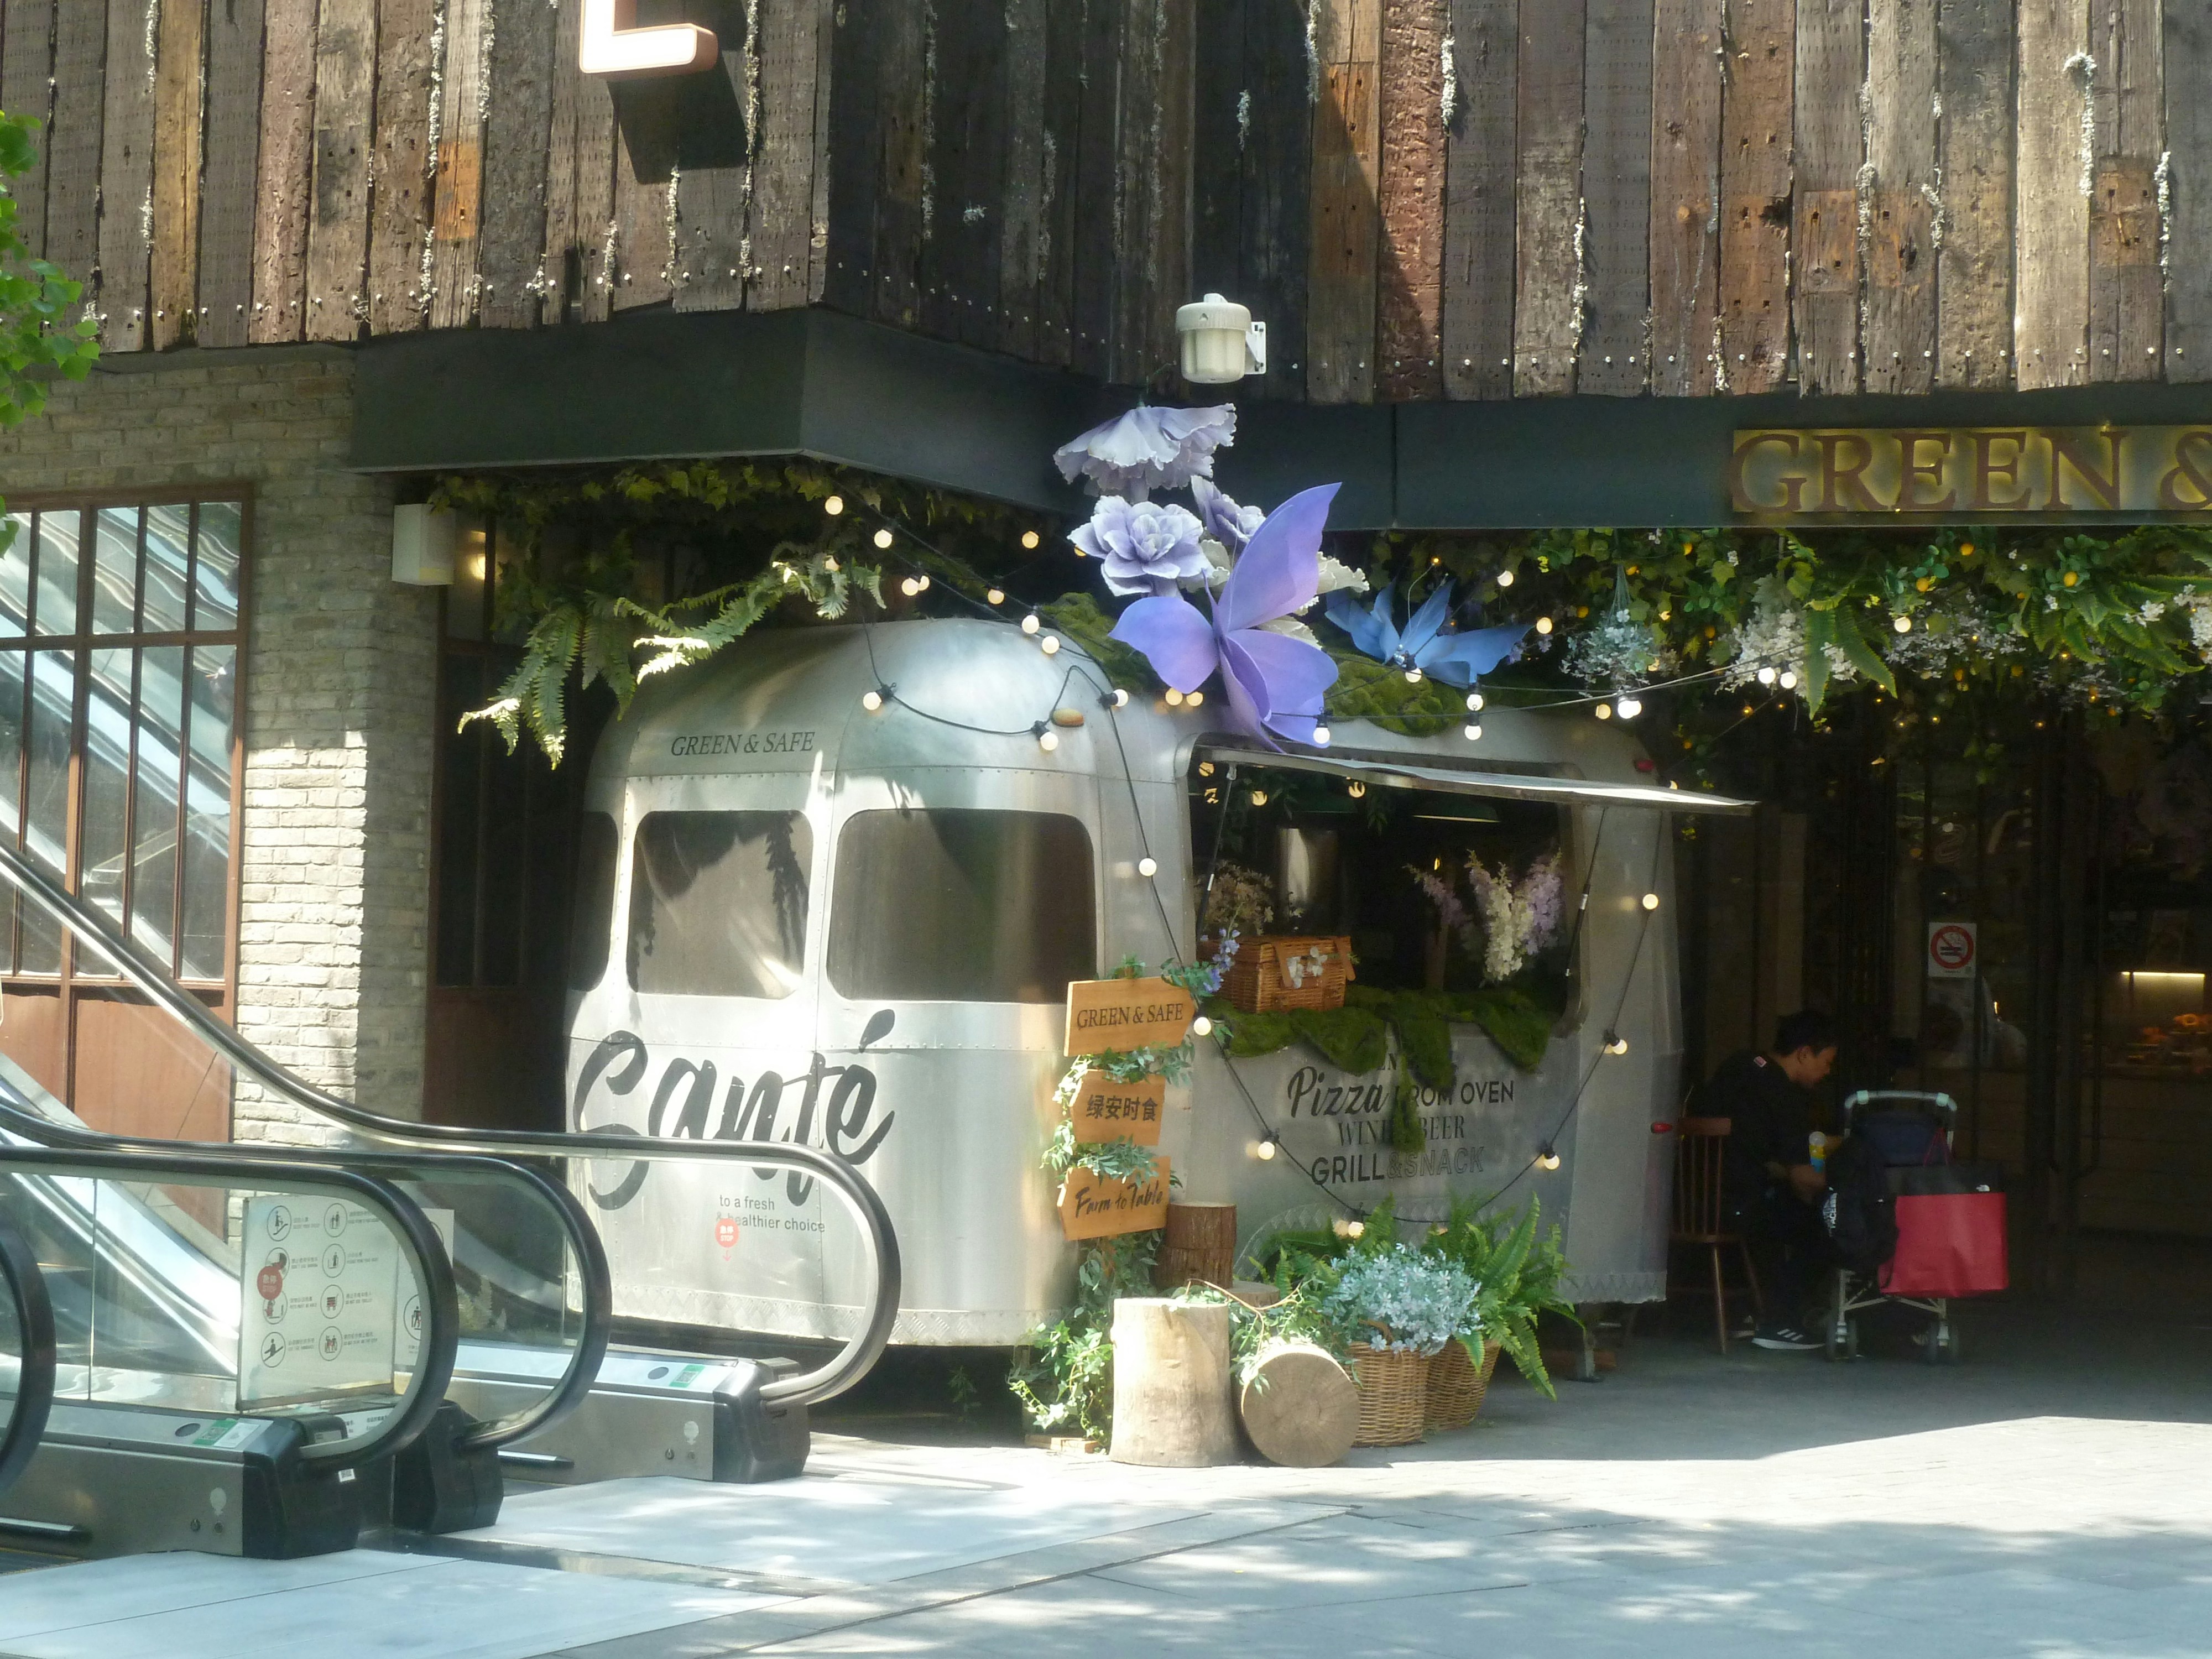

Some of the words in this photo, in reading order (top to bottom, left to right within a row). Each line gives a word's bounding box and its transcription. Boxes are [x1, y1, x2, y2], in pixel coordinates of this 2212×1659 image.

[1728, 430, 2129, 512] GREEN
[671, 734, 742, 756] GREEN
[743, 734, 759, 753] &
[763, 732, 815, 753] SAFE
[1077, 1007, 1130, 1030] GREEN
[1133, 1006, 1144, 1024] &
[1147, 1003, 1183, 1023] SAFE
[1287, 1066, 1388, 1119] Pizza
[1395, 1084, 1453, 1107] ROM
[1460, 1080, 1514, 1104] OVEN
[1086, 1094, 1158, 1122] 绿安时食
[719, 1194, 730, 1207] to
[734, 1198, 740, 1208] a
[744, 1196, 775, 1211] fresh
[1075, 1186, 1111, 1218] Farm
[1115, 1193, 1128, 1209] to
[1126, 1180, 1163, 1212] Table
[784, 1218, 825, 1233] choice
